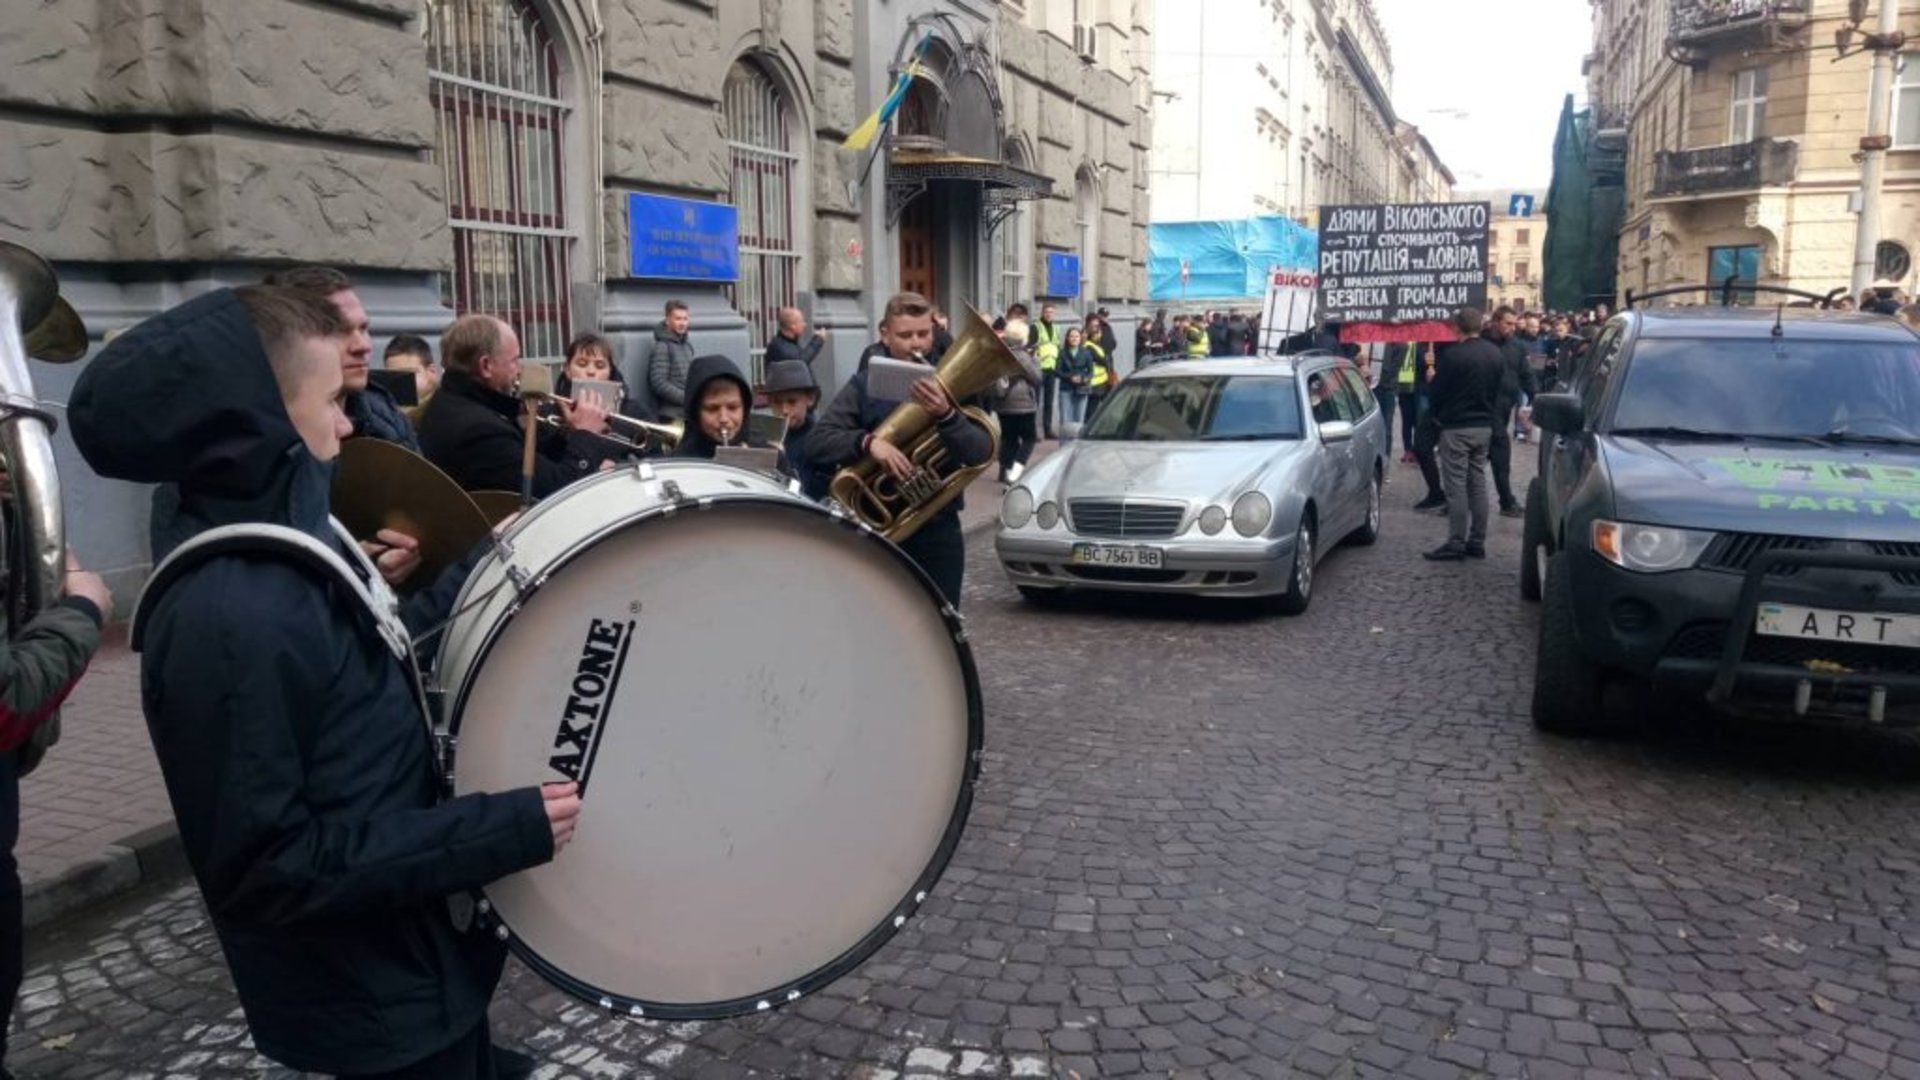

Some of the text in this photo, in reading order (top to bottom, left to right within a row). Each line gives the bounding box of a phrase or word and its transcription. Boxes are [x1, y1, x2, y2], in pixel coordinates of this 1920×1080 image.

[1346, 234, 1369, 249] ТУТ
[1274, 273, 1319, 288] ВІКО
[1327, 286, 1468, 308] БЕЗПЕКА ГРОМАДИ
[1083, 547, 1158, 565] BC 7567 BB
[1801, 611, 1893, 641] ART
[542, 618, 624, 785] AXTONE
